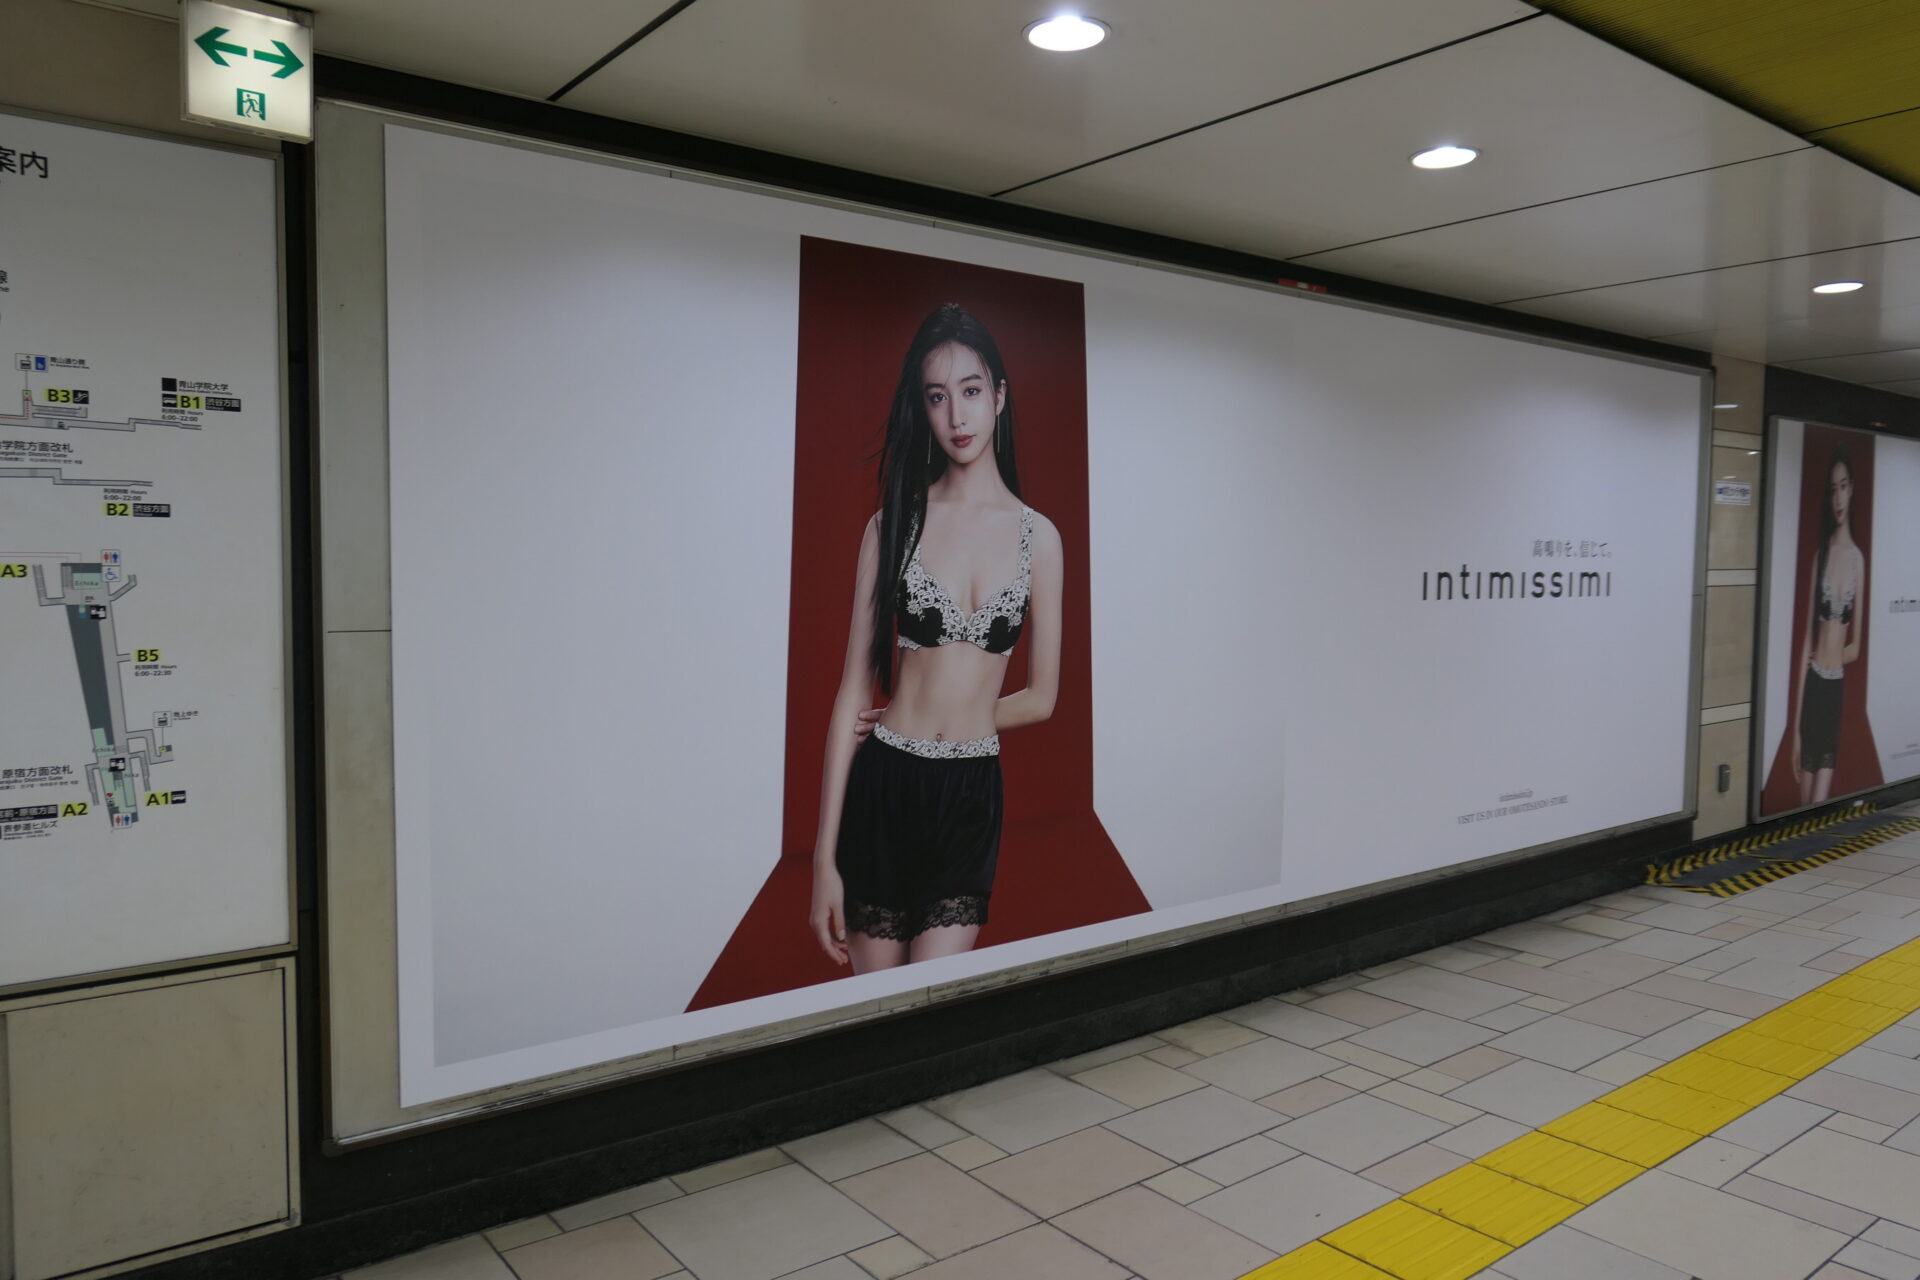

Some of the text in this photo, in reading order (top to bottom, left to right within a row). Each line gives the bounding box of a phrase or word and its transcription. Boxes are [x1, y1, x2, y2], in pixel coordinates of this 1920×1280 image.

[178, 380, 229, 391] 青山学院大学
[47, 388, 71, 403] B3
[180, 395, 201, 409] B1
[0, 440, 74, 453] 学院方面改札
[106, 502, 129, 517] B2
[1, 564, 28, 578] A3
[1422, 564, 1611, 601] intimissimi
[137, 649, 159, 663] B5
[2, 764, 73, 779] 原宿方面改札
[146, 792, 170, 807] A1
[62, 802, 88, 818] A2
